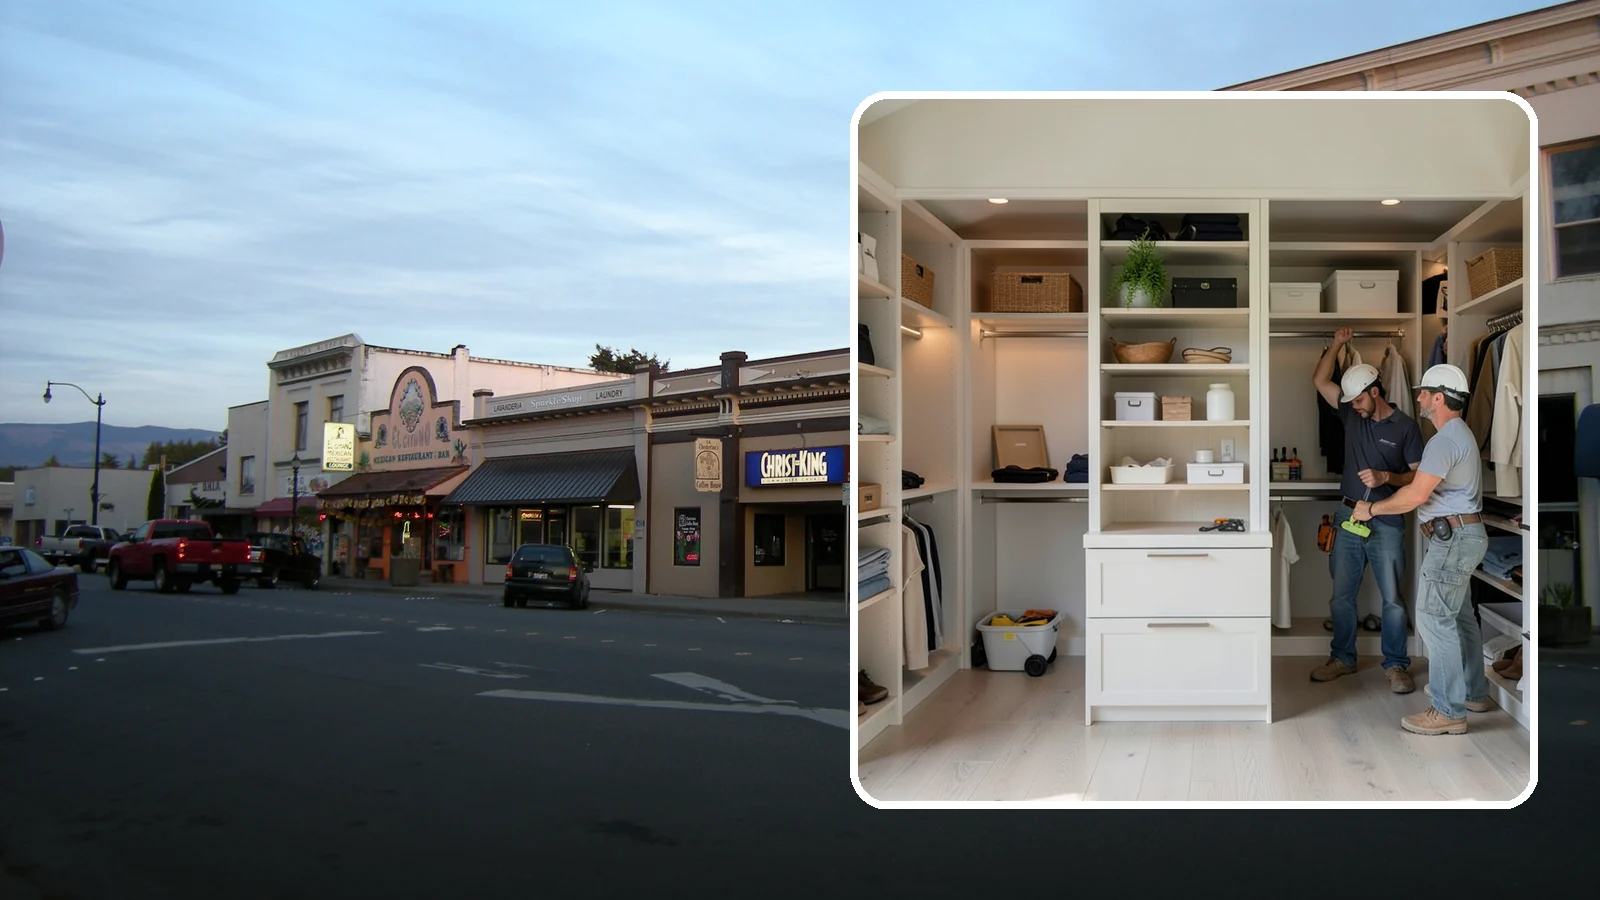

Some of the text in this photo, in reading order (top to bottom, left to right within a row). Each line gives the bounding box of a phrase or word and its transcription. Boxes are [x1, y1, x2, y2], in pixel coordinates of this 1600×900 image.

[561, 394, 583, 406] Shop
[595, 389, 623, 400] LAUNDRY
[493, 402, 522, 412] LAVANDERIA
[373, 455, 396, 464] MEXICAN
[397, 451, 434, 462] RESTAURANT
[437, 450, 450, 459] BAR
[799, 450, 827, 476] KING
